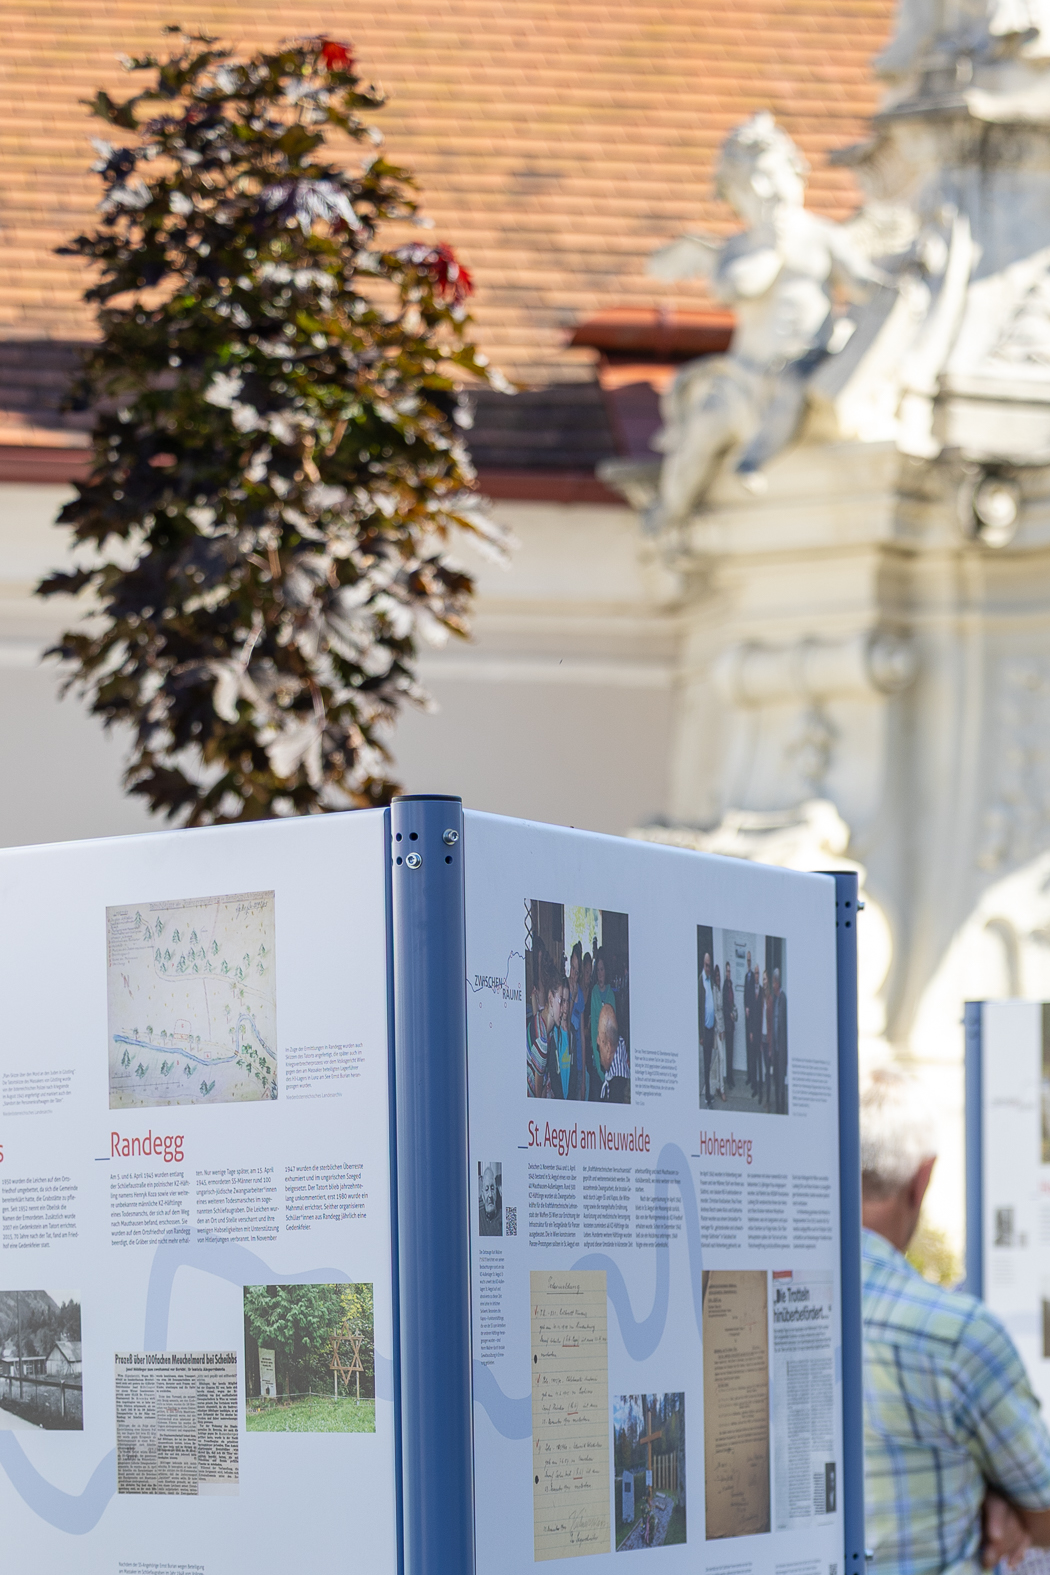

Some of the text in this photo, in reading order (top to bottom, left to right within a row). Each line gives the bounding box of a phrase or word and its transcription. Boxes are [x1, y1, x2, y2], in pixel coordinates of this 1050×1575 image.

[544, 1121, 578, 1156] Aegyd
[581, 1130, 597, 1150] am
[599, 1125, 651, 1152] Neuwalde
[343, 1162, 363, 1170] Überreste
[169, 1171, 184, 1179] entlang
[227, 1168, 236, 1177] Tage
[346, 1172, 363, 1181] Szeged
[181, 1209, 190, 1217] Weg
[323, 1213, 340, 1222] Randegg
[341, 1212, 357, 1220] jährlich
[173, 1227, 191, 1236] Randegg
[115, 1354, 133, 1365] Prozeß
[134, 1354, 145, 1365] über
[172, 1354, 206, 1365] Meuchelmord
[206, 1353, 215, 1365] bei
[215, 1353, 237, 1365] Scheibbs
